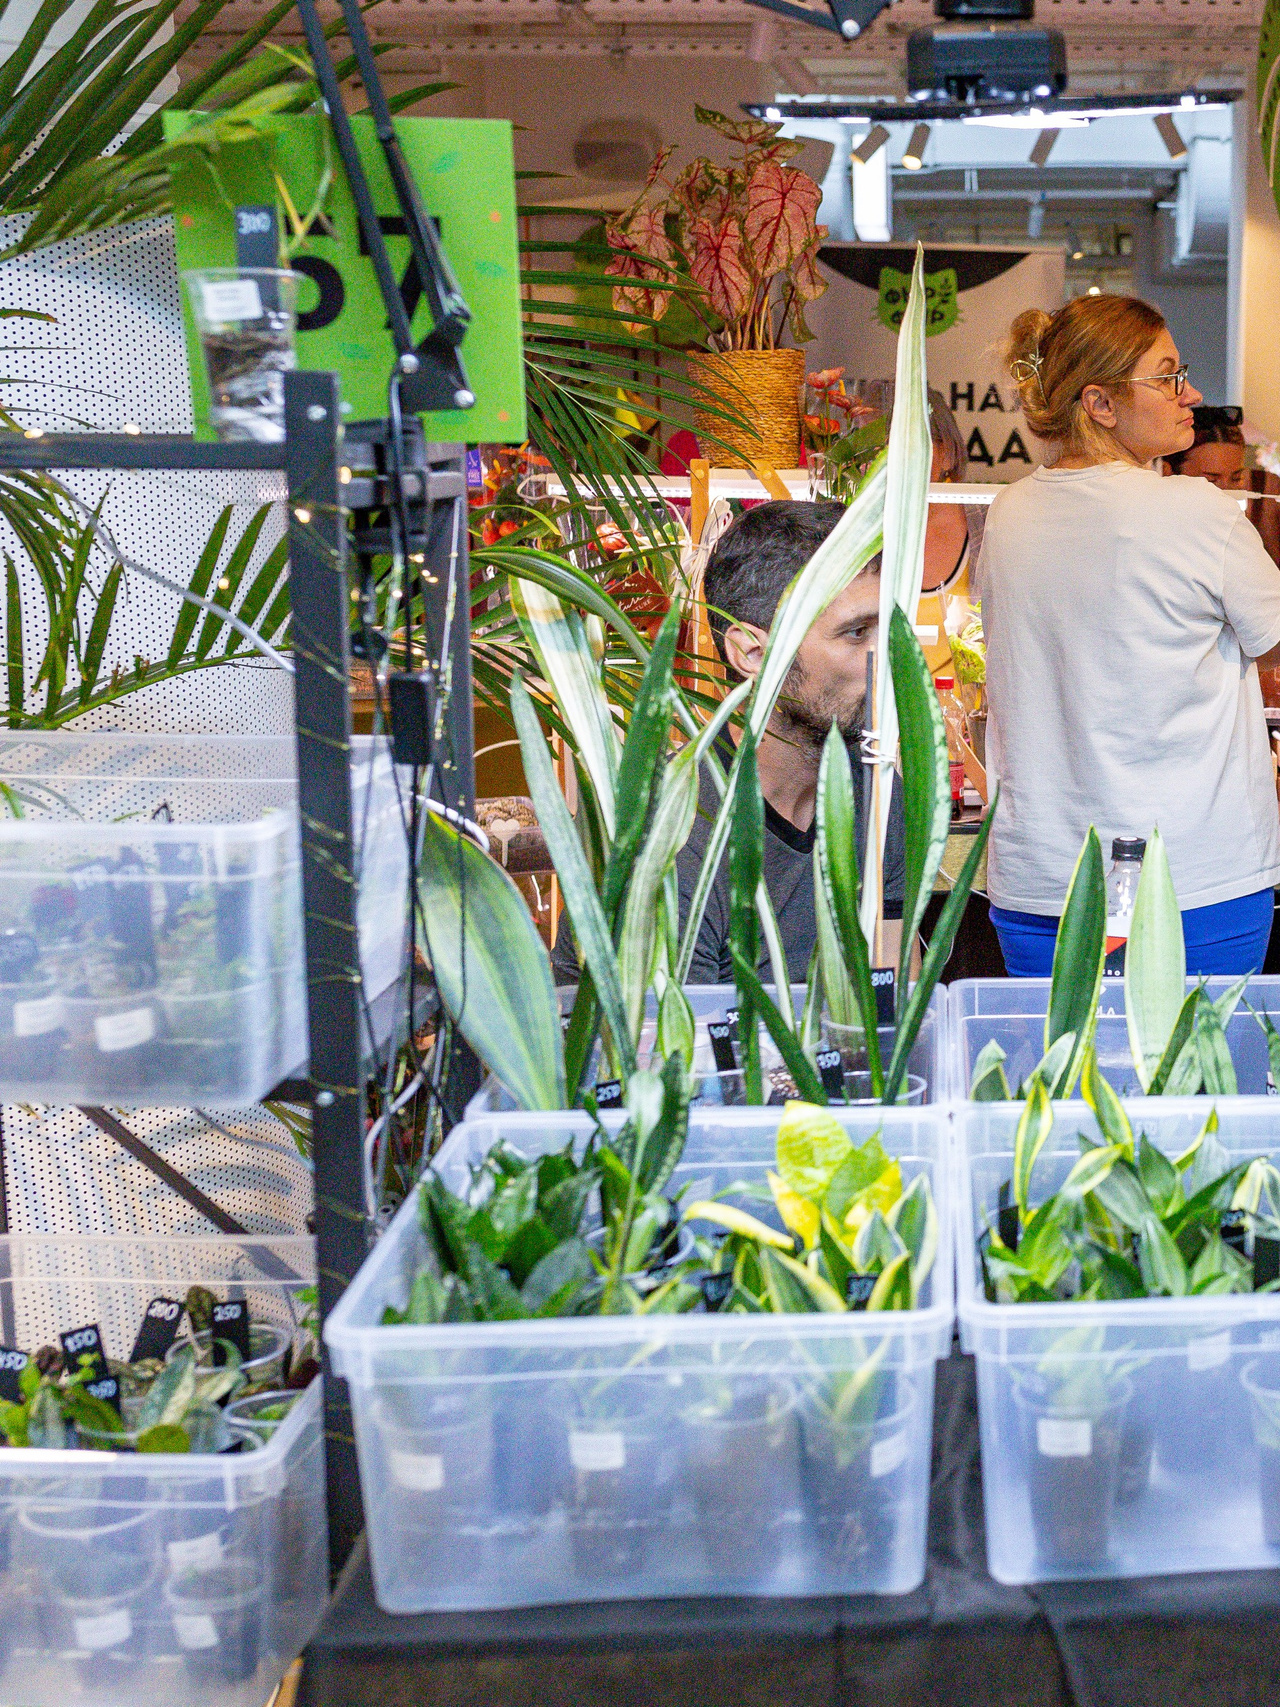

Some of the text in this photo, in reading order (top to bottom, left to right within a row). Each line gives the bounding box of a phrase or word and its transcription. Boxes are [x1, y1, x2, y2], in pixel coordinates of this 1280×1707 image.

[237, 212, 271, 235] 300
[871, 970, 894, 987] 800
[64, 1328, 98, 1353] 150
